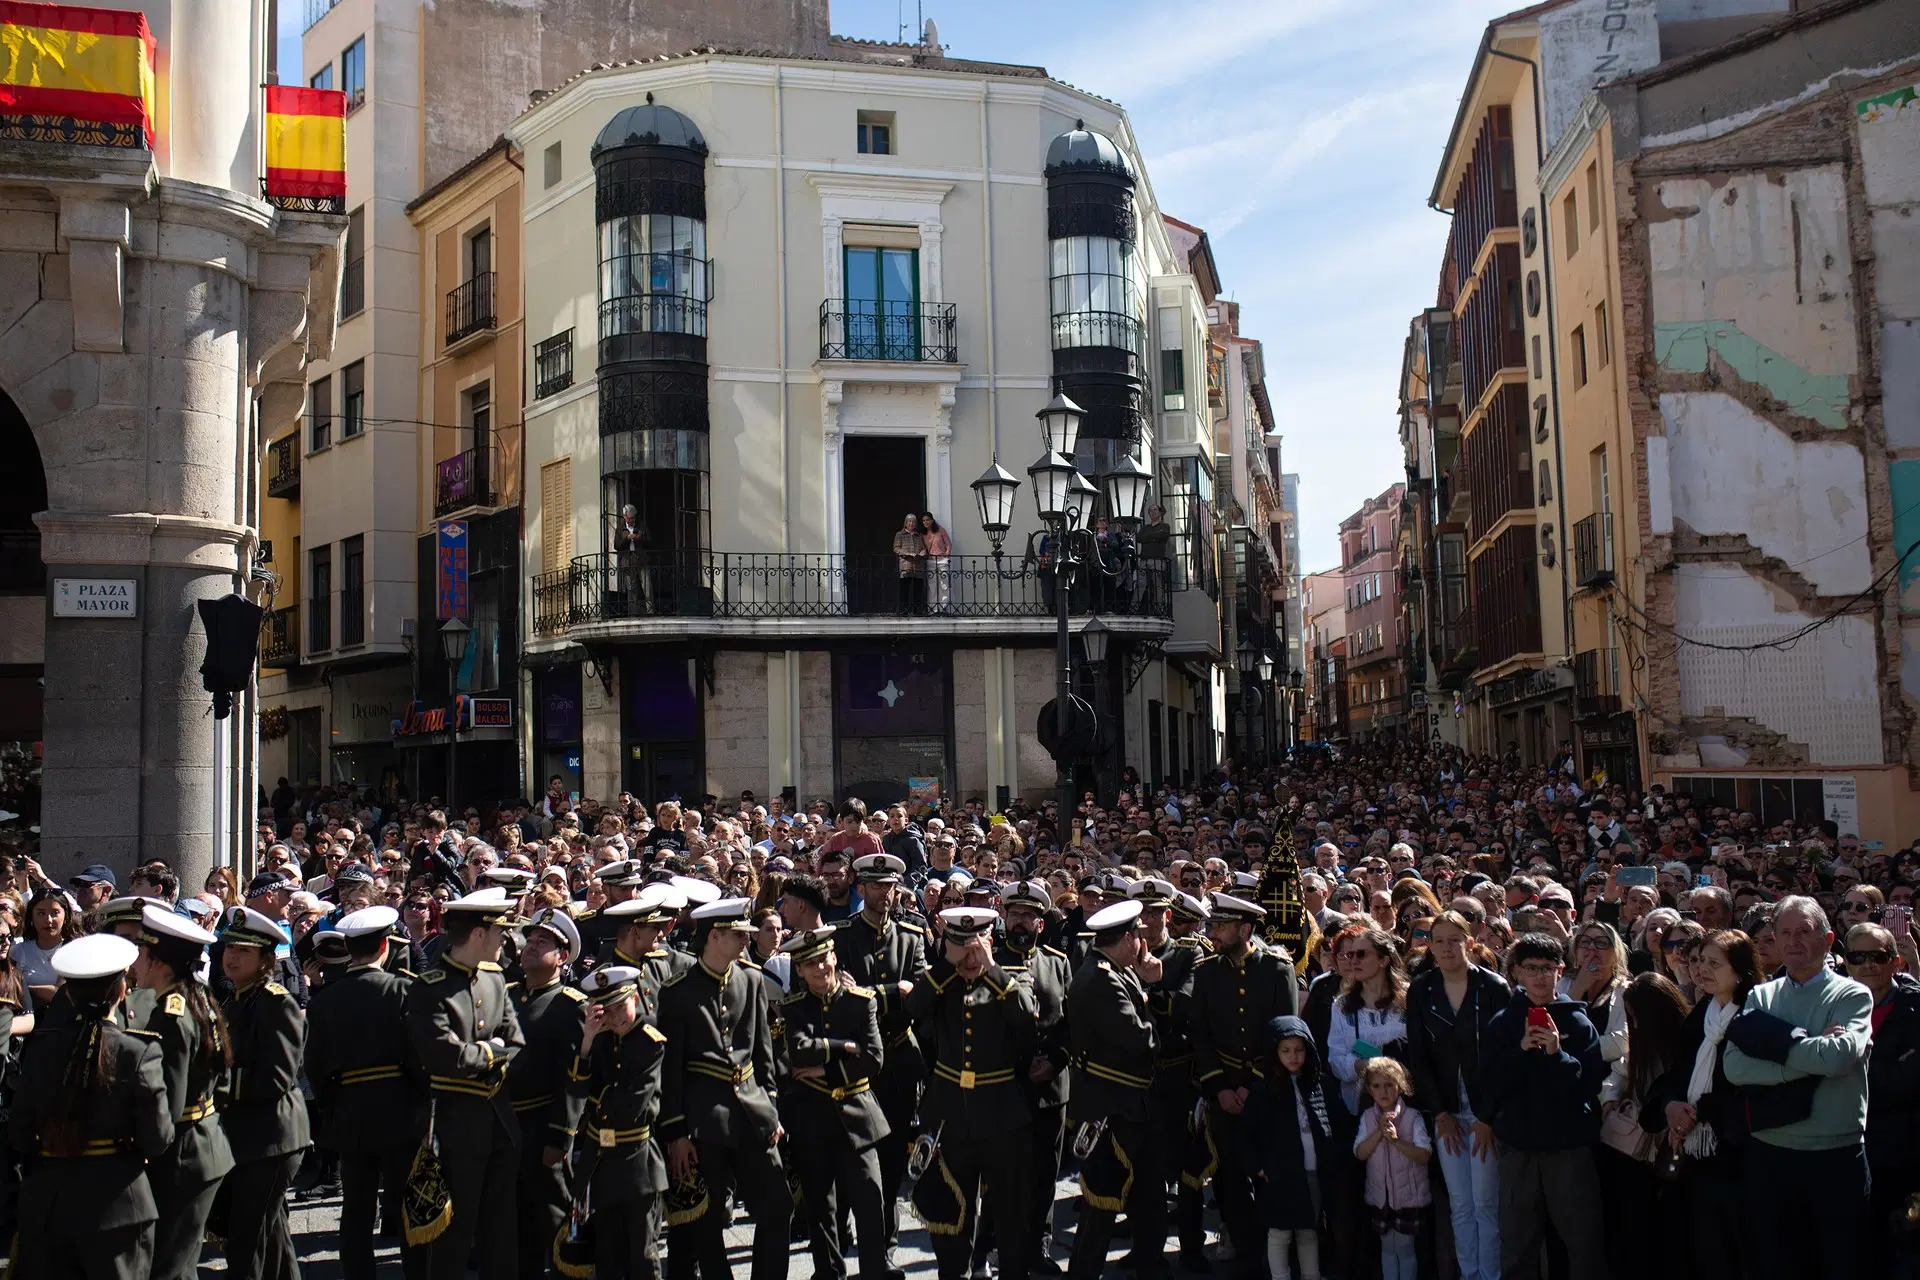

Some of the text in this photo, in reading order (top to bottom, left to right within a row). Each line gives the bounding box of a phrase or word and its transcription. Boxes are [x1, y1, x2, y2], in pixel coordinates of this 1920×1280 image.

[1522, 207, 1556, 569] BOIZAS
[79, 585, 128, 596] PLAZA
[76, 600, 130, 611] MAYOR
[476, 702, 508, 713] BOLSOS
[399, 697, 446, 736] Lema
[475, 714, 510, 724] MALETAS
[1430, 714, 1442, 753] BAR
[1264, 926, 1301, 945] Zamora
